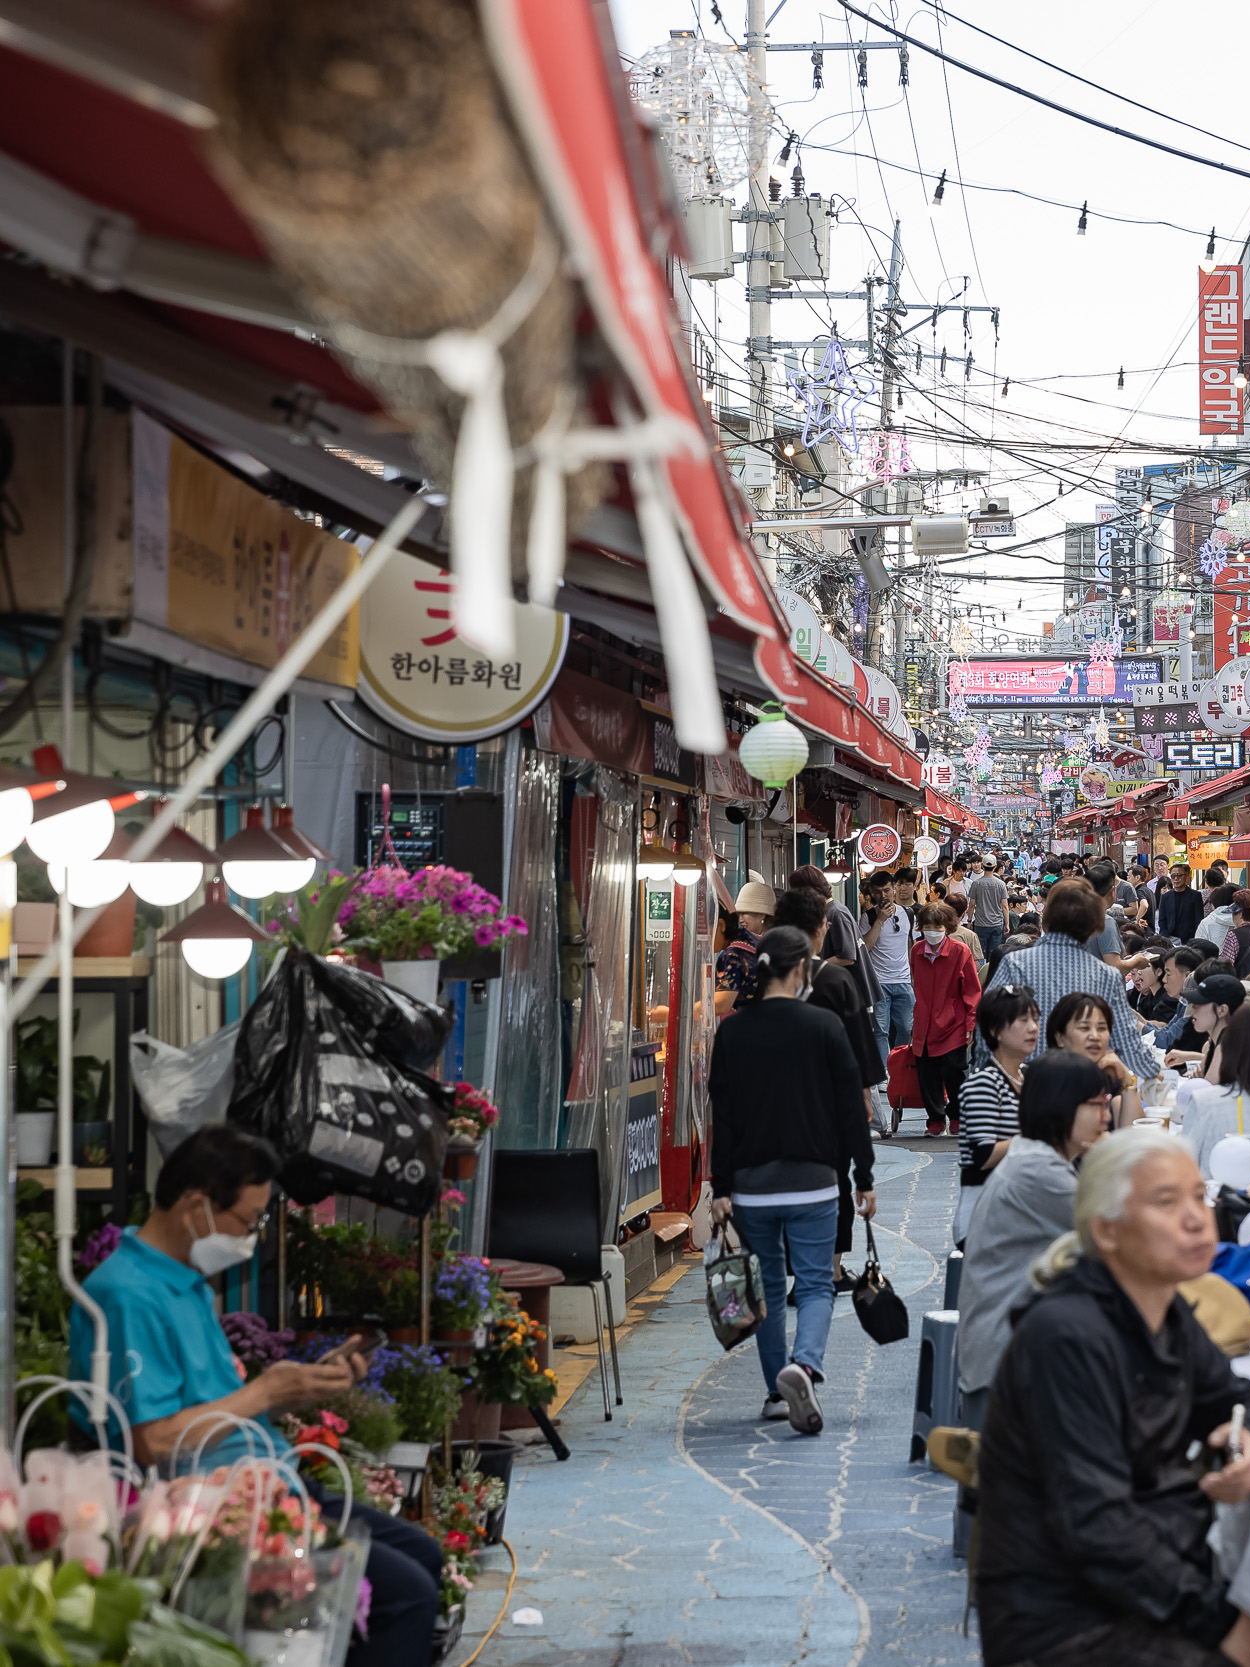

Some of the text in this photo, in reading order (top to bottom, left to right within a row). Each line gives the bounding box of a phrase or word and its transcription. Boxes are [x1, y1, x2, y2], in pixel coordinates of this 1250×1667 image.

[390, 652, 522, 691] 한아름화원
[1145, 684, 1201, 703] 서울떡볶이
[1167, 742, 1241, 770] 도토리
[651, 898, 670, 910] 장수
